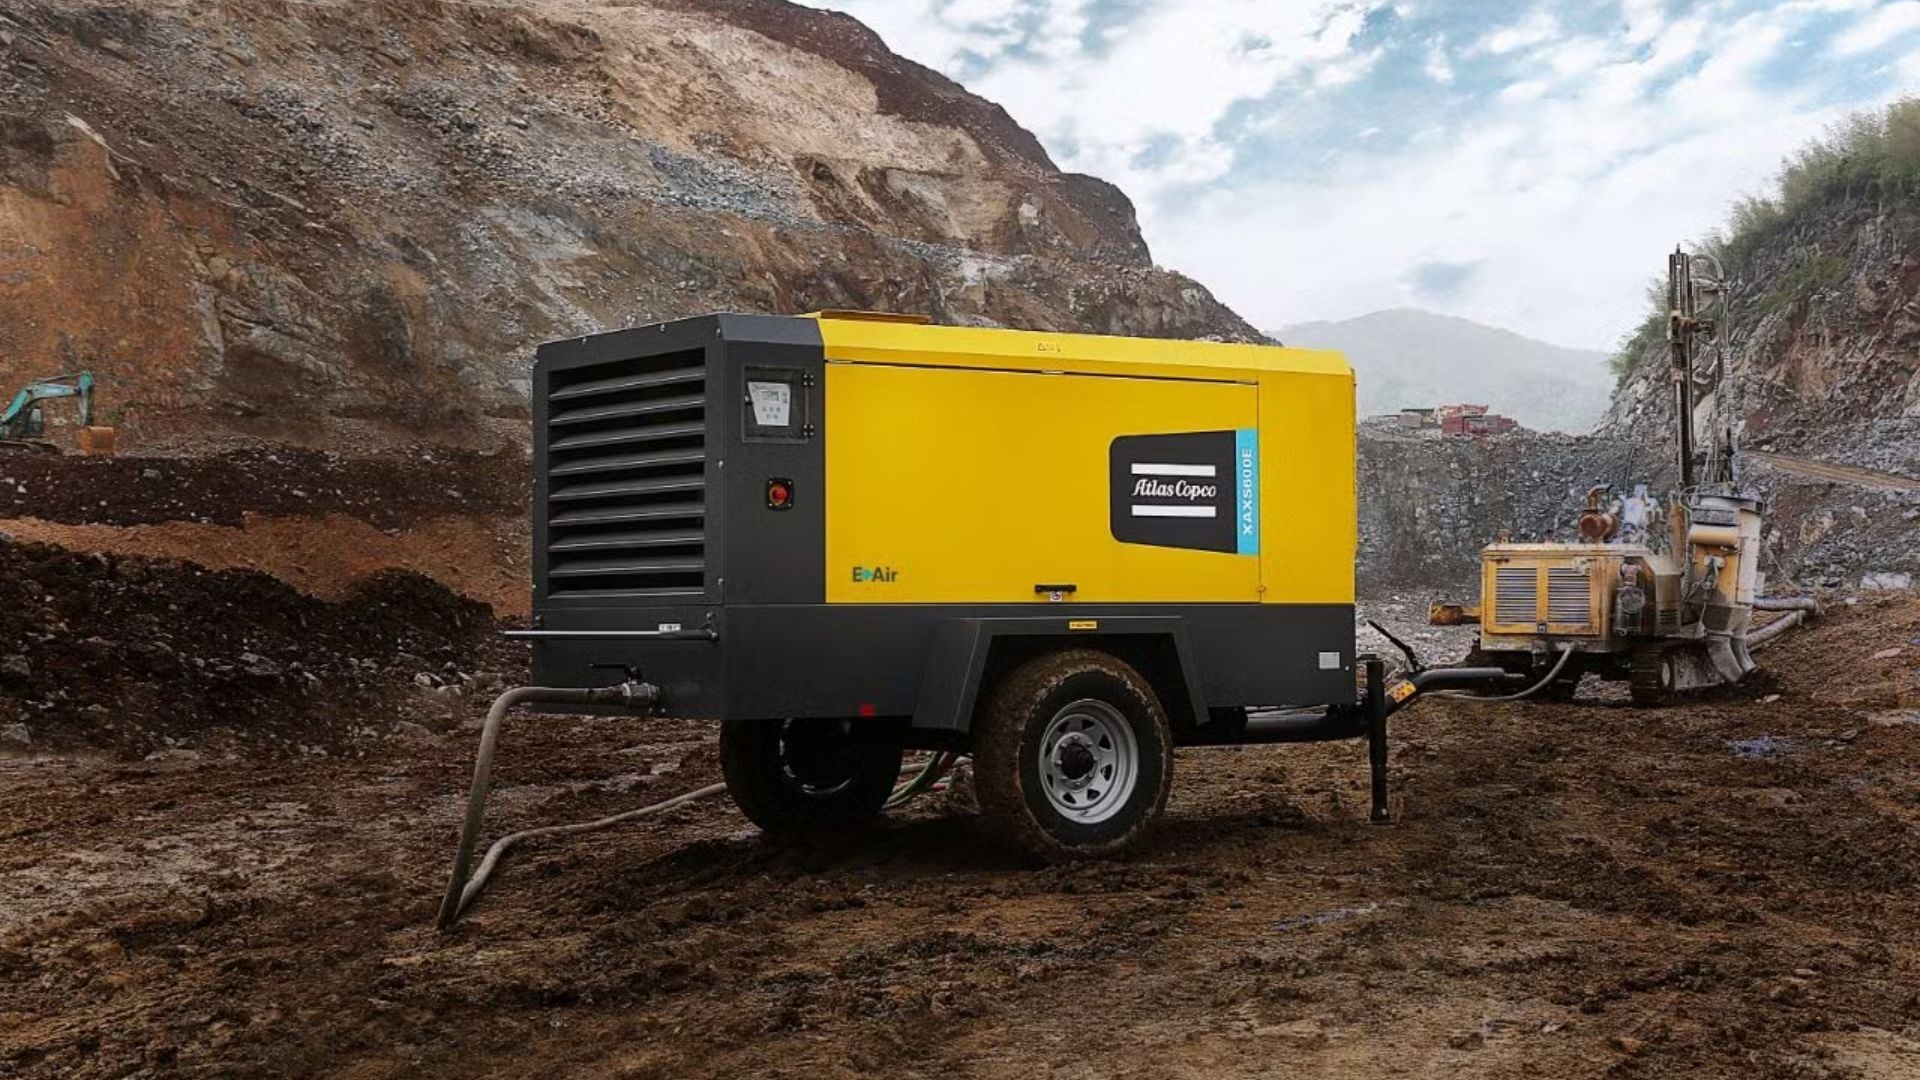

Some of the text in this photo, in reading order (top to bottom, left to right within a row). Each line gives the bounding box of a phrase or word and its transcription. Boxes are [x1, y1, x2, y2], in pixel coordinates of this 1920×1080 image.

[1132, 479, 1216, 500] Atlas Copco
[1242, 449, 1252, 535] XAXS600E
